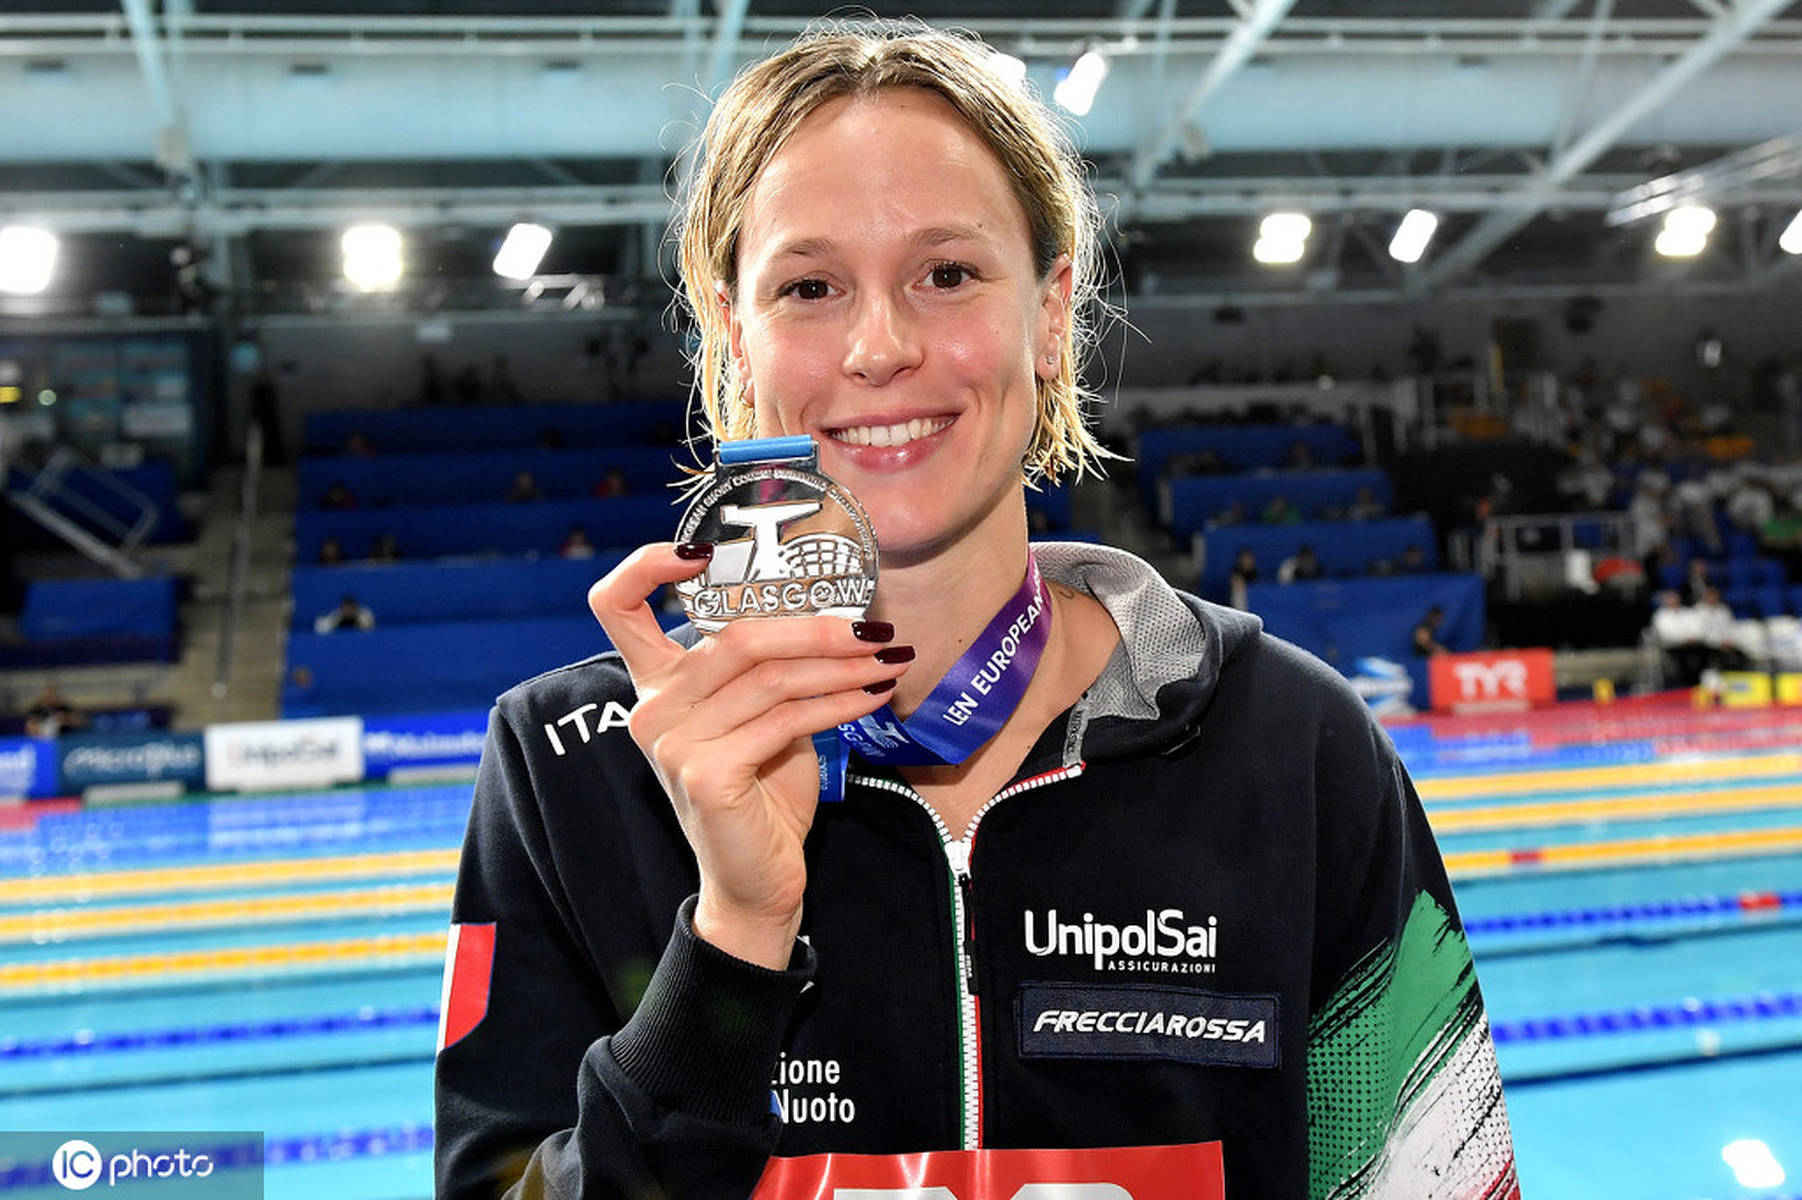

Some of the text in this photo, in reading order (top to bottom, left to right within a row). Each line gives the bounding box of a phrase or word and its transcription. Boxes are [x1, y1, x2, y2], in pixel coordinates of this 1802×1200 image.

[694, 578, 866, 616] GLASGOW
[943, 594, 1043, 726] LEN EUROPEAN
[1453, 660, 1528, 697] TYR
[543, 701, 630, 756] ITA
[1024, 909, 1218, 970] UnipolSai
[1108, 960, 1216, 974] ASSICURAZIONI
[1033, 1010, 1266, 1043] FRECCIAROSSA
[771, 1051, 840, 1085] ione
[772, 1088, 855, 1124] Nuoto
